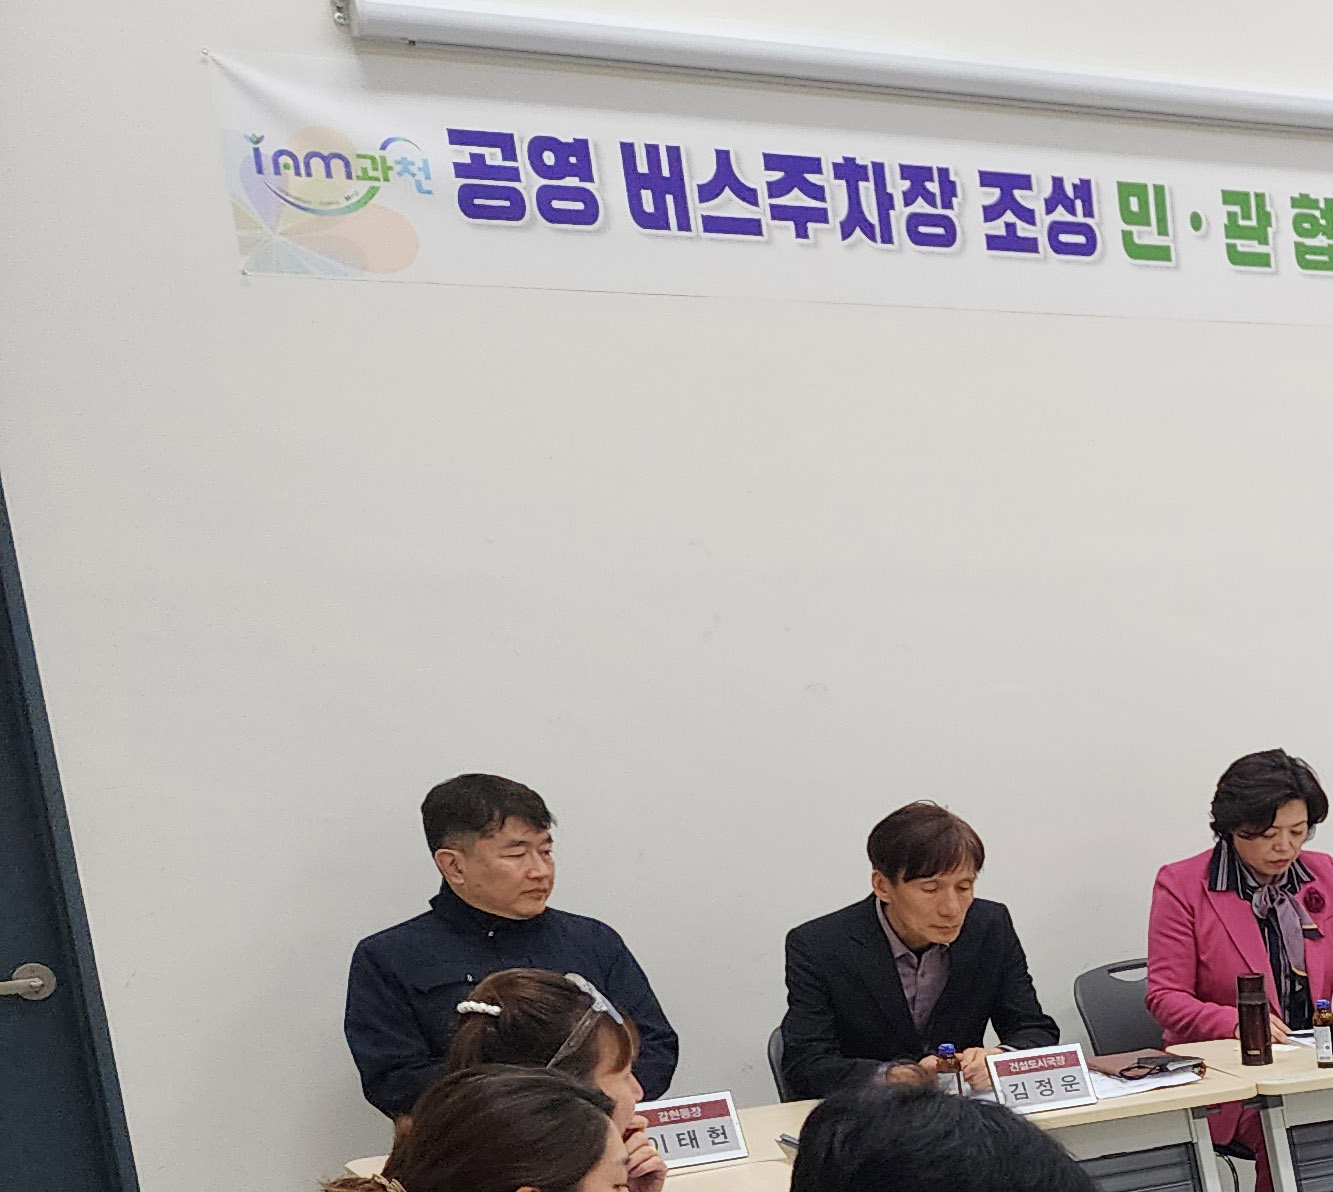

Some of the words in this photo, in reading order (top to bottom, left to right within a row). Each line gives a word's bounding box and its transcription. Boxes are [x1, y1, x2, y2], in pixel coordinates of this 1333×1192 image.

[446, 127, 600, 227] 공영
[619, 142, 959, 249] 버스주차장
[978, 170, 1098, 258] 조성
[1008, 1074, 1081, 1101] 김정운
